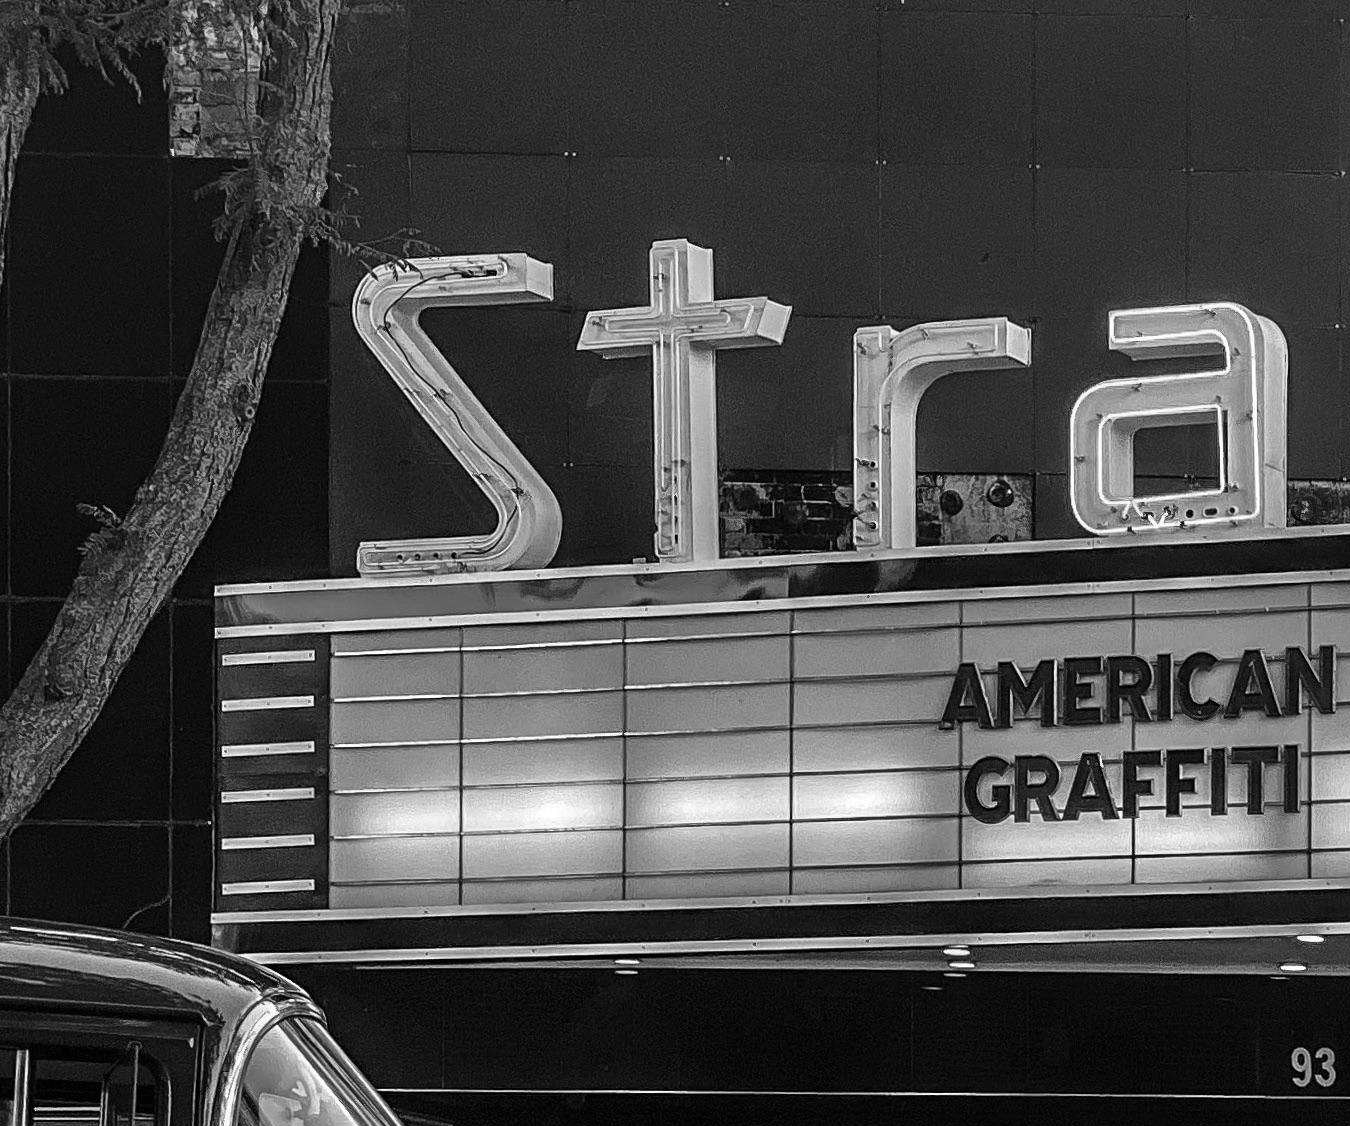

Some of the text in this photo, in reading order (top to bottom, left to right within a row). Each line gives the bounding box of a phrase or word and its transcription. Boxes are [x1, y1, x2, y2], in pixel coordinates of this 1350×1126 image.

[938, 643, 1337, 731] AMERICAN
[962, 743, 1304, 825] GRAFFITI
[1291, 1046, 1337, 1088] 93
